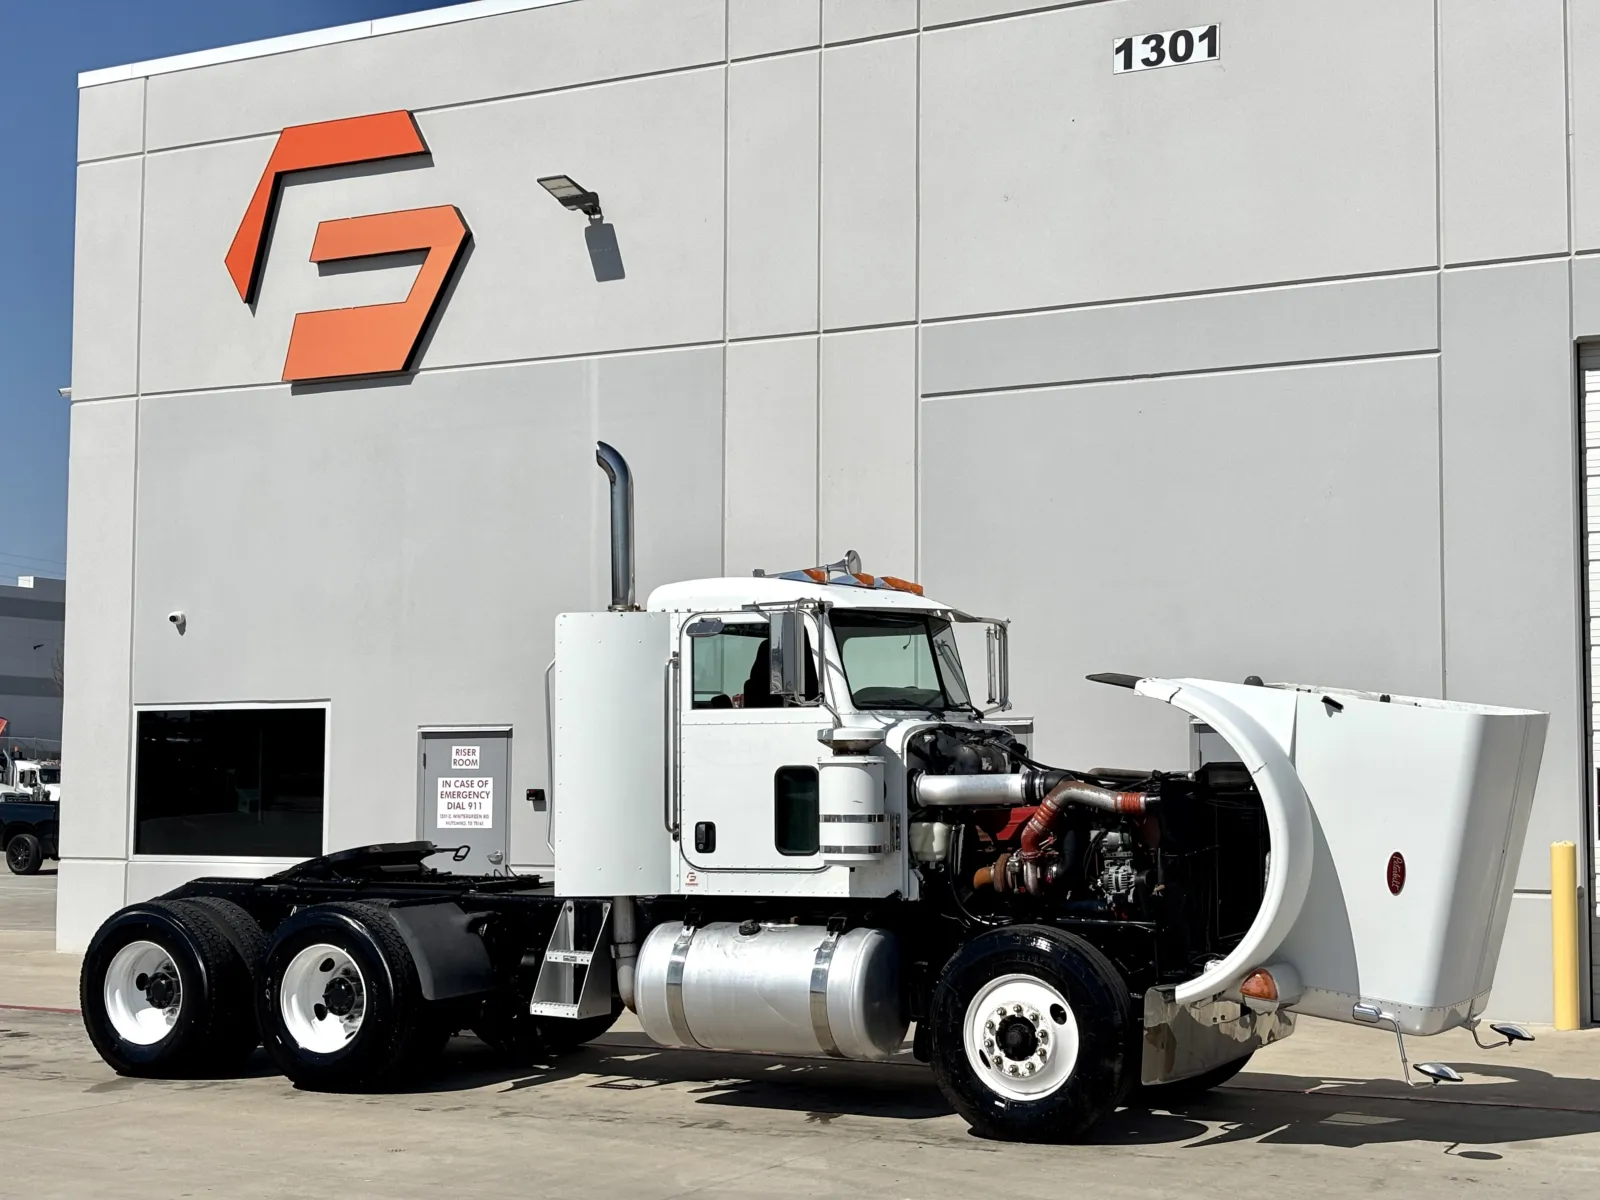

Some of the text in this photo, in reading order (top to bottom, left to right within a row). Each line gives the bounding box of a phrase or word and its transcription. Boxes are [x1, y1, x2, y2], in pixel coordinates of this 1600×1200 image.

[1115, 25, 1217, 70] 1301
[455, 748, 477, 757] RISER
[453, 758, 478, 767] ROOM
[442, 780, 489, 788] IN CASE OF
[440, 791, 490, 799] EMERGENCY
[447, 801, 482, 810] DIAL 911
[1392, 855, 1403, 891] Peterbilt
